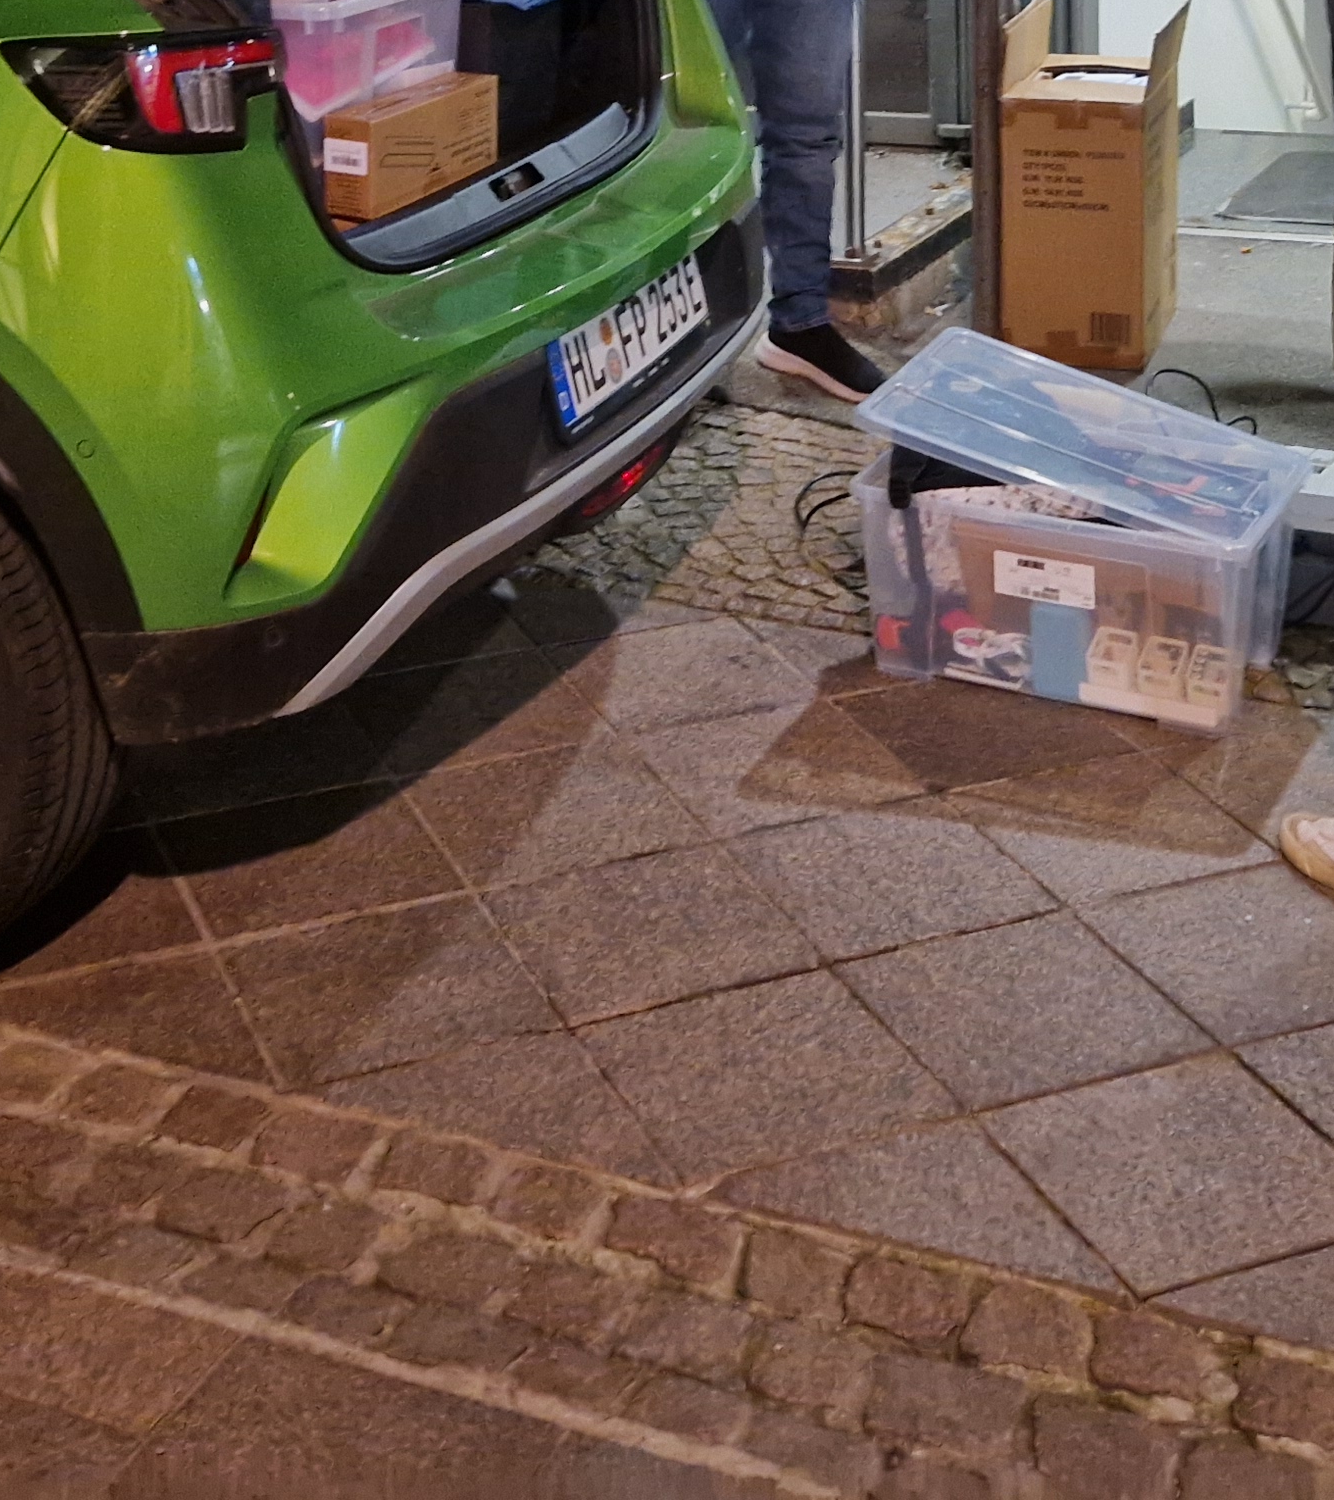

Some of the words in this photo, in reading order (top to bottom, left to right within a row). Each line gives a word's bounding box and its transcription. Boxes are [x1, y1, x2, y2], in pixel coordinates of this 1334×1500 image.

[565, 331, 606, 403] HL
[613, 295, 647, 368] FP
[649, 257, 702, 344] 253E
